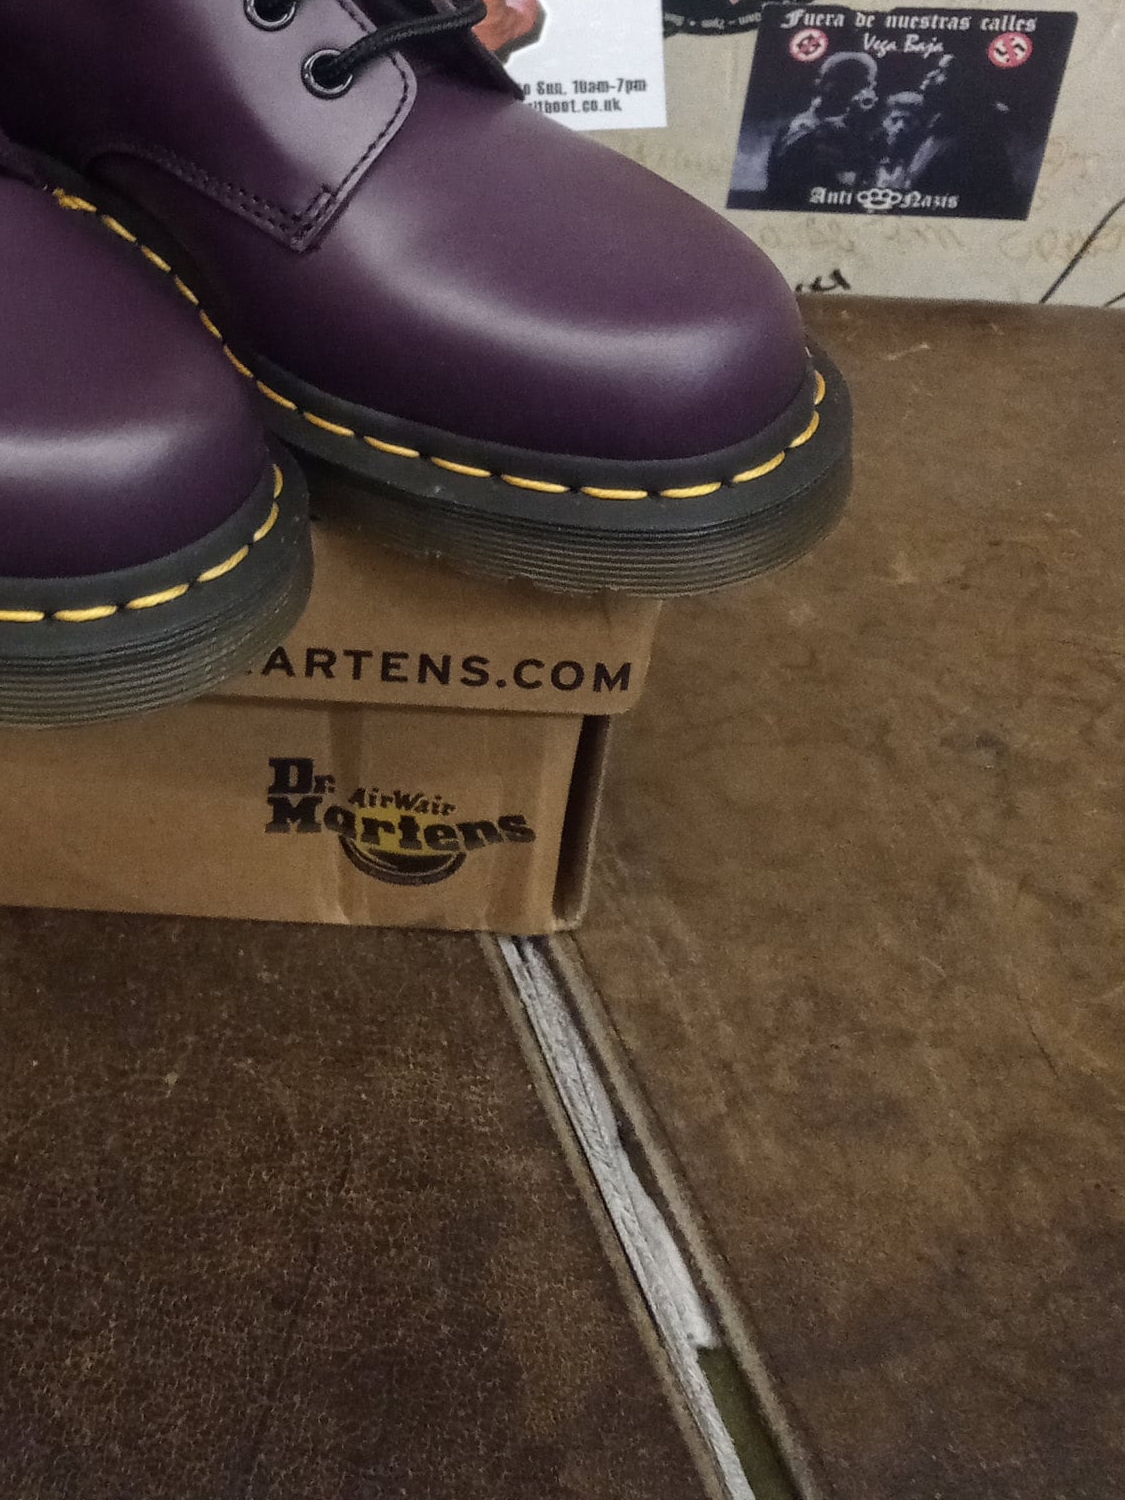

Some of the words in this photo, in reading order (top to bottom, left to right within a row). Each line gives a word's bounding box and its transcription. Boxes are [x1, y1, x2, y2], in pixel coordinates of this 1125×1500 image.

[780, 8, 845, 29] Fuera
[855, 11, 875, 28] de
[885, 12, 972, 30] nuestras
[979, 14, 1038, 32] calles
[863, 32, 897, 58] Vega
[903, 32, 945, 59] Baja
[809, 187, 853, 205] Anti
[899, 191, 960, 209] Nazis
[259, 644, 633, 693] ARTENS.COM
[268, 757, 336, 795] Dr.
[348, 788, 457, 817] AirWair
[265, 795, 537, 852] Martens
